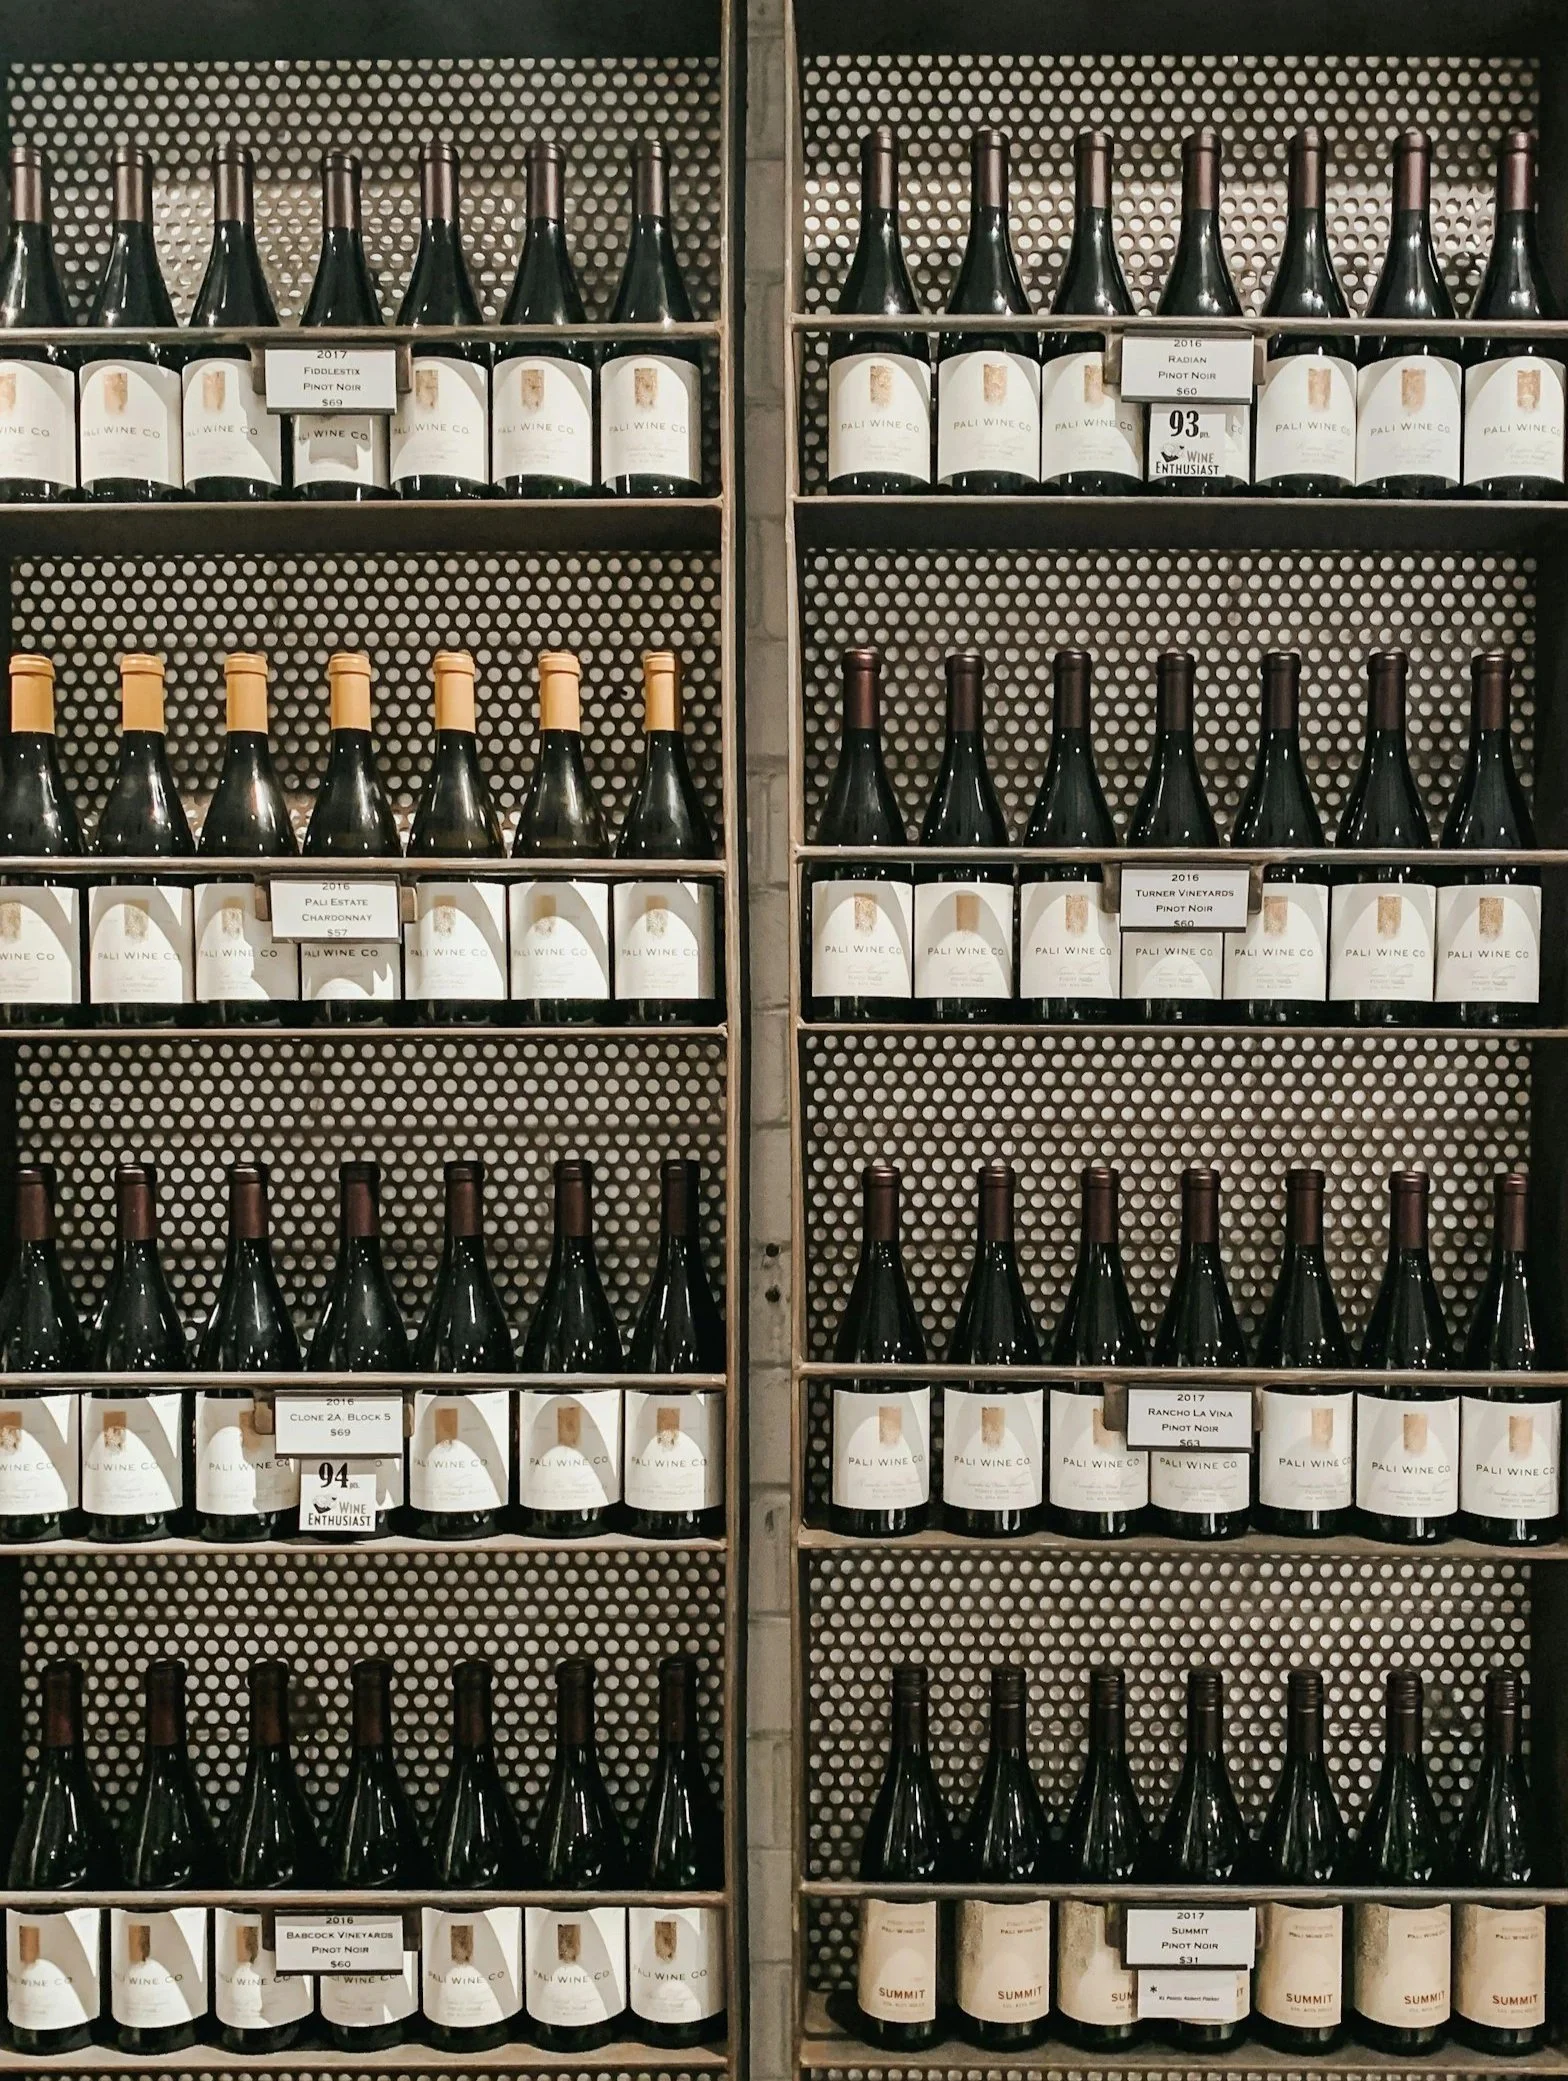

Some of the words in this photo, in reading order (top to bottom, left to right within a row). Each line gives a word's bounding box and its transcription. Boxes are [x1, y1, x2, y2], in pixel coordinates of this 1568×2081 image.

[1173, 339, 1202, 348] 2016
[316, 350, 348, 359] 2017
[1168, 355, 1208, 364] RADIAN
[303, 367, 361, 375] FIDDLESTIX
[1158, 371, 1189, 380] PINOT
[1191, 371, 1216, 380] NOIR
[303, 382, 334, 391] PINOT
[336, 383, 362, 392] NOIR
[1176, 387, 1198, 396] $60
[321, 398, 343, 407] $69
[415, 423, 447, 432] WINE
[520, 422, 553, 432] WINE
[633, 421, 666, 431] WINE
[841, 420, 865, 432] PALI
[870, 418, 901, 429] WINE
[953, 419, 979, 430] PALI
[982, 417, 1014, 428] WINE
[1054, 420, 1079, 432] PALI
[1084, 418, 1116, 428] WINE
[1169, 410, 1200, 438] 93
[1275, 422, 1303, 433] PALI
[1307, 421, 1337, 432] WINE
[104, 426, 137, 435] WINE
[203, 424, 234, 433] WINE
[1370, 424, 1396, 436] PALI
[1400, 422, 1432, 431] WINE
[1483, 424, 1512, 436] PALI
[1516, 422, 1547, 433] WINE
[313, 430, 346, 438] WINE
[1187, 450, 1215, 464] WINE
[1155, 461, 1220, 475] ENTHUSIAST
[1171, 874, 1199, 882] 2016
[322, 882, 350, 891] 2016
[1136, 889, 1176, 897] TURNER
[1178, 889, 1234, 897] VINEYARDS
[305, 898, 328, 907] PALI
[330, 898, 368, 906] ESTATE
[1156, 905, 1186, 913] PINOT
[1188, 905, 1213, 913] NOIR
[301, 913, 373, 922] CHARDONNAY
[327, 928, 348, 937] $57
[222, 949, 253, 958] WINE
[324, 949, 356, 957] WINE
[434, 948, 466, 957] WINE
[534, 947, 565, 956] WINE
[646, 948, 678, 957] WINE
[824, 945, 848, 954] PALI
[853, 945, 884, 954] WINE
[927, 947, 950, 956] PALI
[956, 947, 986, 956] WINE
[1035, 947, 1060, 955] PALI
[1065, 946, 1095, 956] WINE
[1135, 947, 1159, 956] PALI
[1164, 947, 1196, 956] WINE
[1234, 949, 1258, 958] PALI
[1262, 949, 1295, 957] WINE
[1345, 949, 1371, 958] PALI
[1376, 949, 1408, 958] WINE
[124, 952, 158, 960] WINE
[1447, 950, 1473, 959] PALI
[1478, 950, 1511, 959] WINE
[326, 1398, 354, 1406] 2016
[1177, 1394, 1205, 1402] 2017
[290, 1414, 324, 1422] CLONE
[347, 1413, 381, 1421] BLOCK
[384, 1413, 391, 1421] 5
[1148, 1408, 1190, 1417] RANCHO
[1193, 1409, 1206, 1417] LA
[1209, 1410, 1233, 1418] VINA
[330, 1428, 351, 1436] $69
[1161, 1424, 1191, 1432] PINOT
[1194, 1424, 1219, 1433] NOIR
[1179, 1439, 1200, 1447] $63
[208, 1463, 233, 1471] PALI
[238, 1460, 273, 1471] WINE
[433, 1460, 466, 1469] WINE
[556, 1459, 589, 1468] WINE
[655, 1459, 687, 1468] WINE
[848, 1456, 872, 1466] PALI
[877, 1457, 908, 1466] WINE
[953, 1455, 975, 1466] PALI
[981, 1458, 1011, 1467] WINE
[1063, 1457, 1087, 1467] PALI
[1091, 1459, 1123, 1468] WINE
[1159, 1457, 1182, 1468] PALI
[1186, 1461, 1218, 1470] WINE
[1278, 1457, 1305, 1468] PALI
[1310, 1459, 1339, 1468] WINE
[103, 1463, 136, 1471] WINE
[1371, 1462, 1396, 1473] PALI
[1402, 1465, 1434, 1474] WINE
[1475, 1464, 1502, 1475] PALI
[1507, 1467, 1540, 1476] WINE
[318, 1462, 349, 1488] 94
[339, 1501, 367, 1514] WINE
[308, 1513, 371, 1527] ENTHUSIAST
[326, 1916, 354, 1925] 2016
[1176, 1912, 1205, 1920] 2017
[286, 1931, 335, 1939] BABCOCK
[1171, 1927, 1209, 1935] SUMMIT
[311, 1946, 342, 1954] PINOT
[344, 1946, 369, 1954] NOIR
[1161, 1941, 1191, 1950] PINOT
[1193, 1942, 1219, 1950] NOIR
[330, 1960, 351, 1968] $60
[1179, 1956, 1198, 1964] $31
[129, 1976, 159, 1985] WINE
[451, 1976, 482, 1984] WINE
[557, 1975, 589, 1984] WINE
[654, 1972, 686, 1981] WINE
[20, 1978, 49, 1987] WINE
[237, 1978, 267, 1986] WINE
[878, 1987, 925, 2000] SUMMIT
[997, 1986, 1043, 2000] SUMMIT
[1404, 1990, 1445, 2005] SUMMIT
[1286, 1992, 1332, 2005] SUMMIT
[1492, 1994, 1538, 2005] SUMMIT
